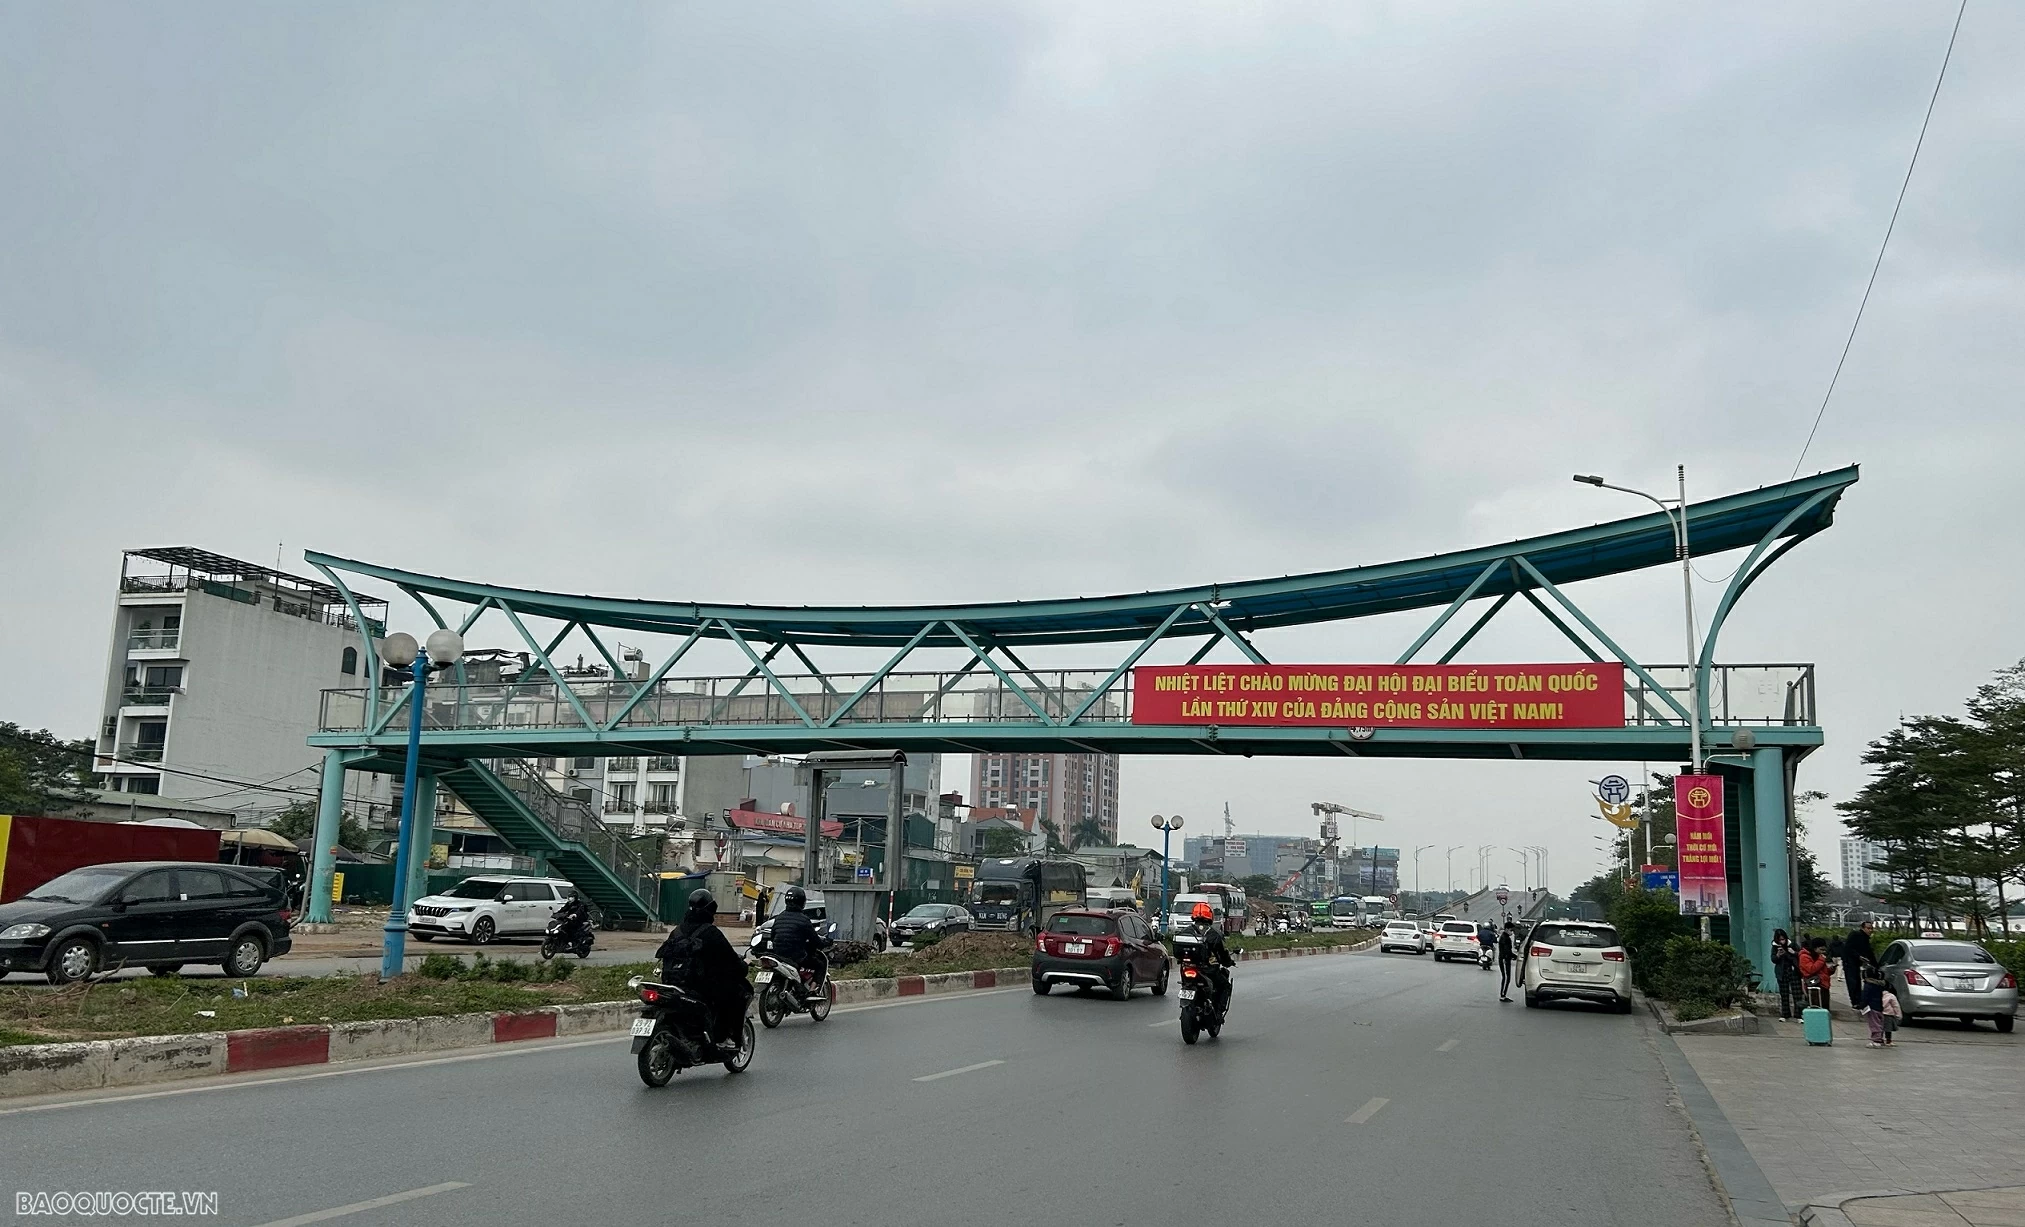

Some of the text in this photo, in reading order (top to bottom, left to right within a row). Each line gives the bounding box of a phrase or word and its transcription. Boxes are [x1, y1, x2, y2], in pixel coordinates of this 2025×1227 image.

[1155, 669, 1598, 695] NHIỆT LIỆT CHÀO MỪNG ĐẠI HỘI ĐẠI BIỂU TOÀN QUỐC
[1182, 696, 1563, 723] LẦN THỨ XIV CỦA ĐẢNG CỘNG SẢN VIỆT NAM!
